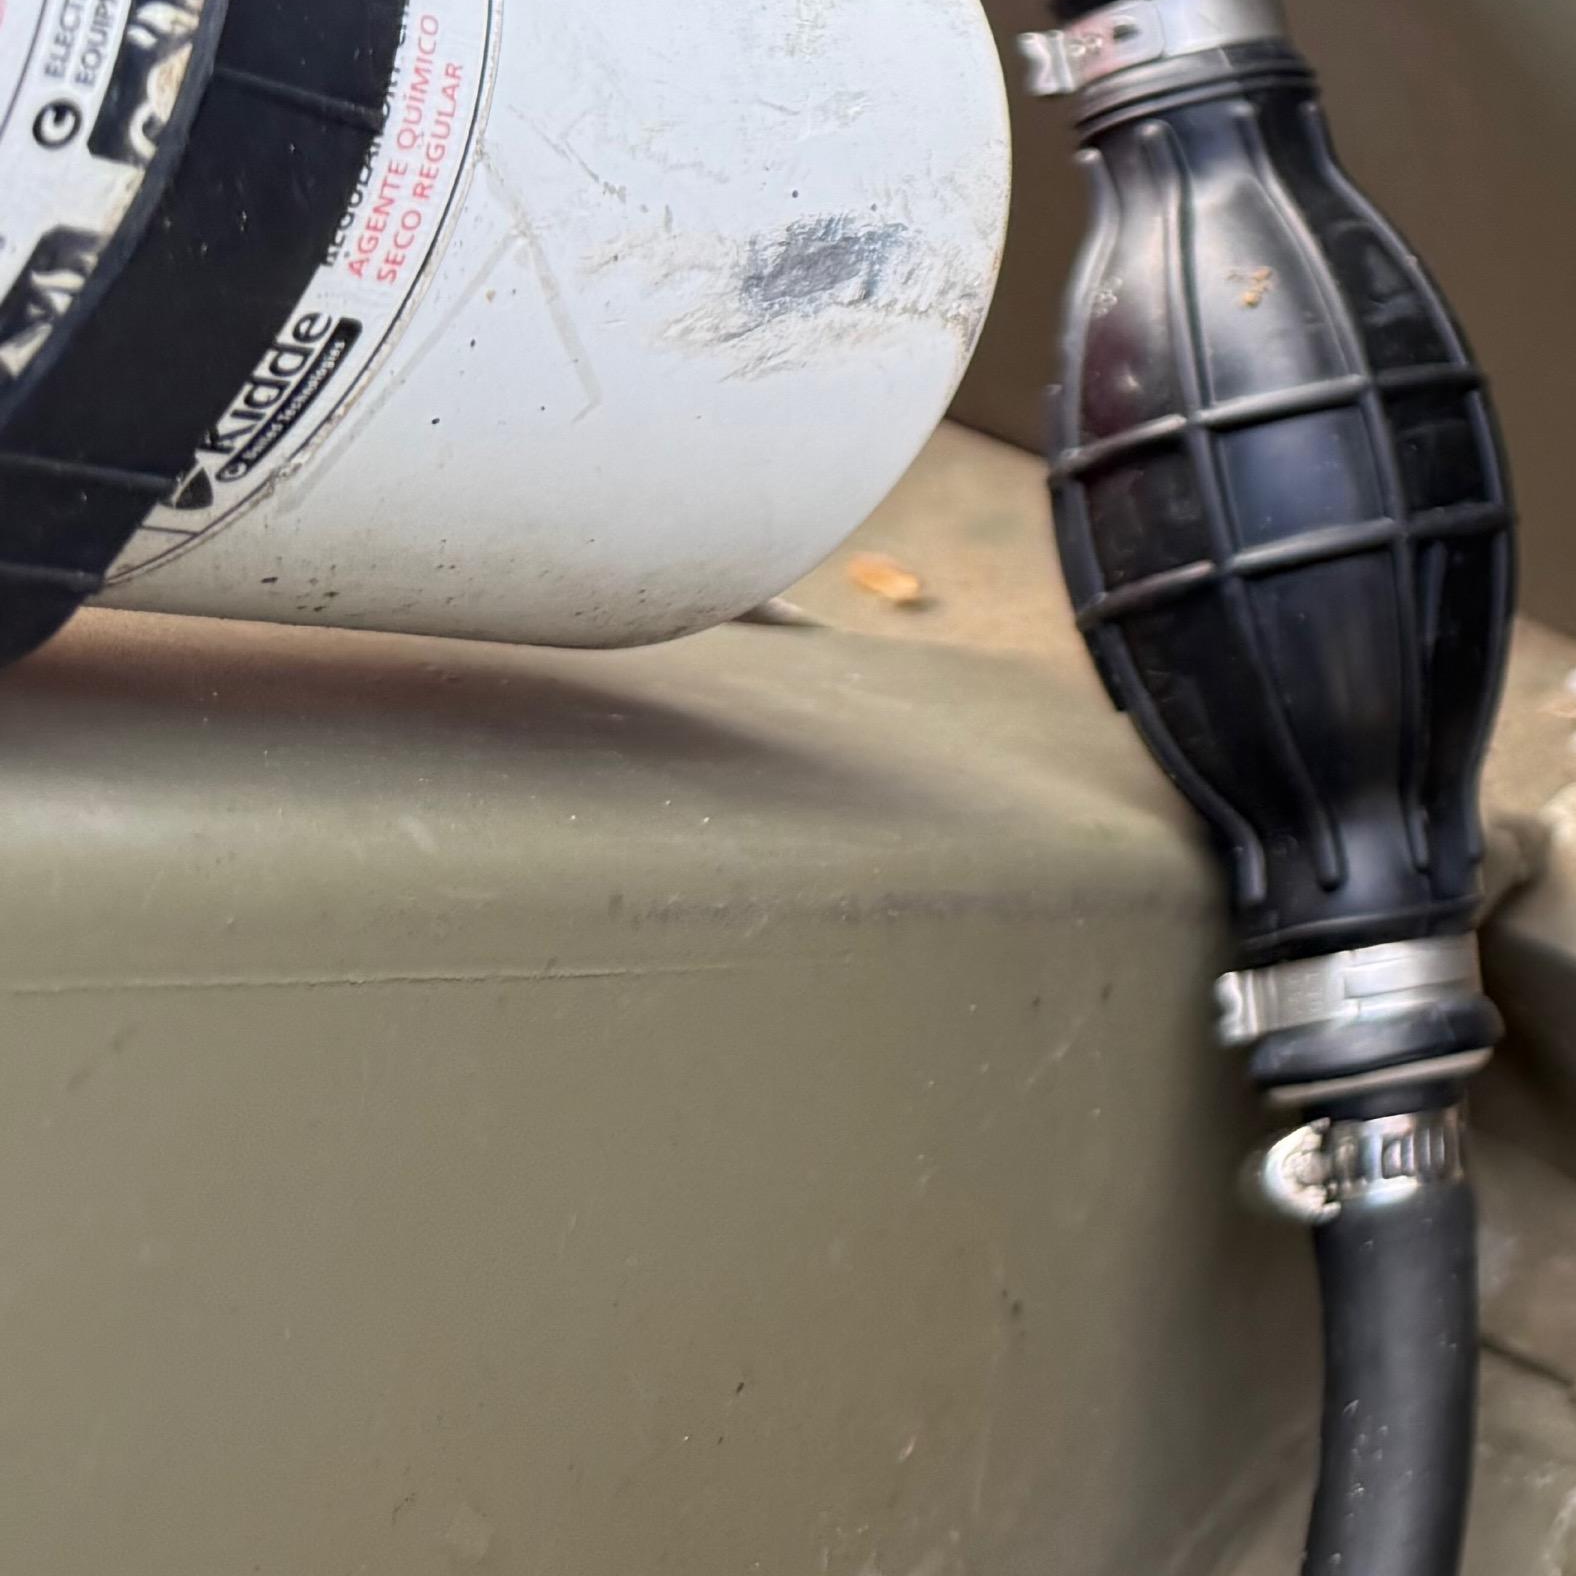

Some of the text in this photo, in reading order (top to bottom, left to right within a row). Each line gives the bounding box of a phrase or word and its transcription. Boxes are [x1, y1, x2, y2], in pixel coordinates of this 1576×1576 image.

[349, 156, 408, 278] AGENTE
[377, 61, 464, 284] SECO REGULAR
